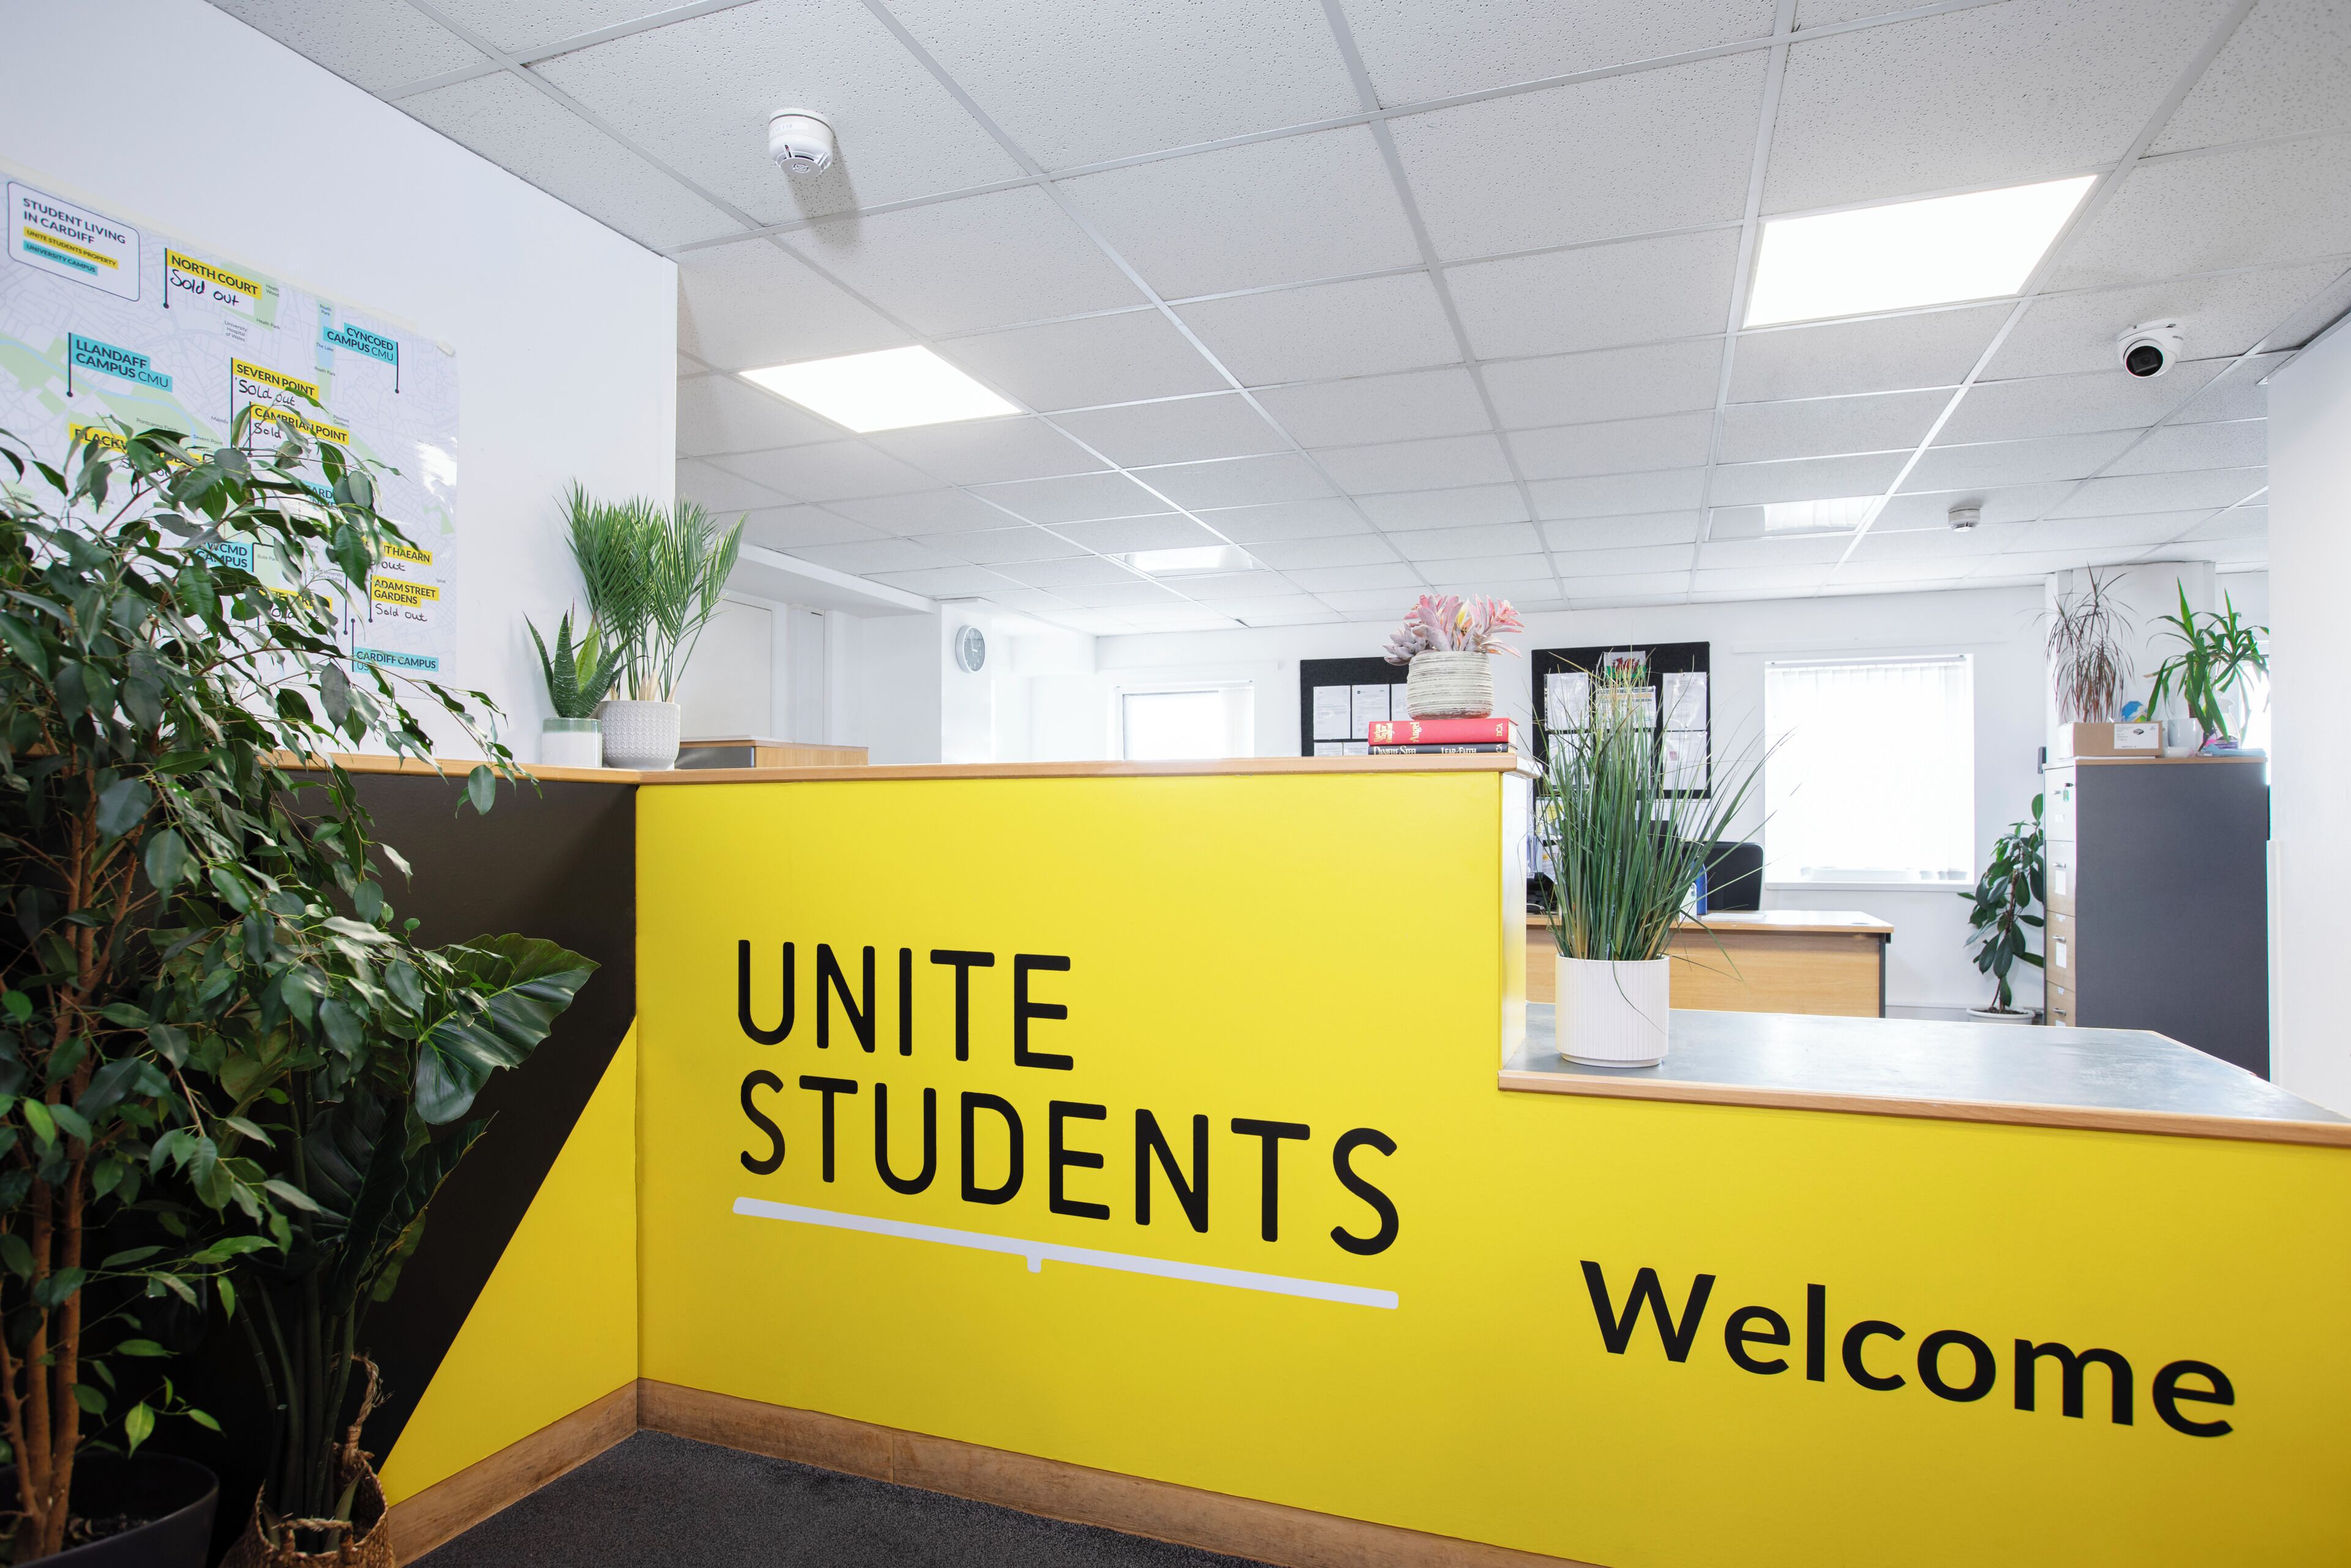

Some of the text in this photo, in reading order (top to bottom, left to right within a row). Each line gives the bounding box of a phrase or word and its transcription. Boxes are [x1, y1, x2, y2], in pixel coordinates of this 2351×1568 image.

[23, 198, 126, 244] STUDENT LIVING
[24, 211, 95, 243] IN CARDIFF
[27, 230, 116, 266] UNITE STUDENTS PROPERTY
[27, 244, 96, 272] UNIVERSITY CAMPUS
[171, 255, 258, 294] NORTH COURT
[170, 269, 239, 306] Sold out
[225, 320, 247, 332] University
[227, 328, 246, 336] Hospital
[327, 331, 394, 361] CAMPUS CMU
[347, 328, 394, 351] CYNCOED
[77, 339, 147, 368] LLANDAFF
[76, 353, 168, 388] CAMPUS CMU
[236, 364, 315, 396] SEVERN POINT
[239, 380, 272, 399] Sold
[211, 416, 228, 424] Maindy
[254, 422, 281, 439] Sold
[316, 425, 347, 441] POINT
[393, 547, 430, 563] HAEARN
[374, 590, 418, 604] GARDENS
[375, 579, 436, 598] ADAM STREET
[375, 603, 427, 621] Sold out
[357, 651, 436, 669] CARDIFF CAMPUS
[1409, 722, 1422, 743] Angel
[738, 940, 1073, 1071] UNITE
[741, 1070, 1399, 1256] STUDENTS
[1580, 1260, 2235, 1438] Welcome
